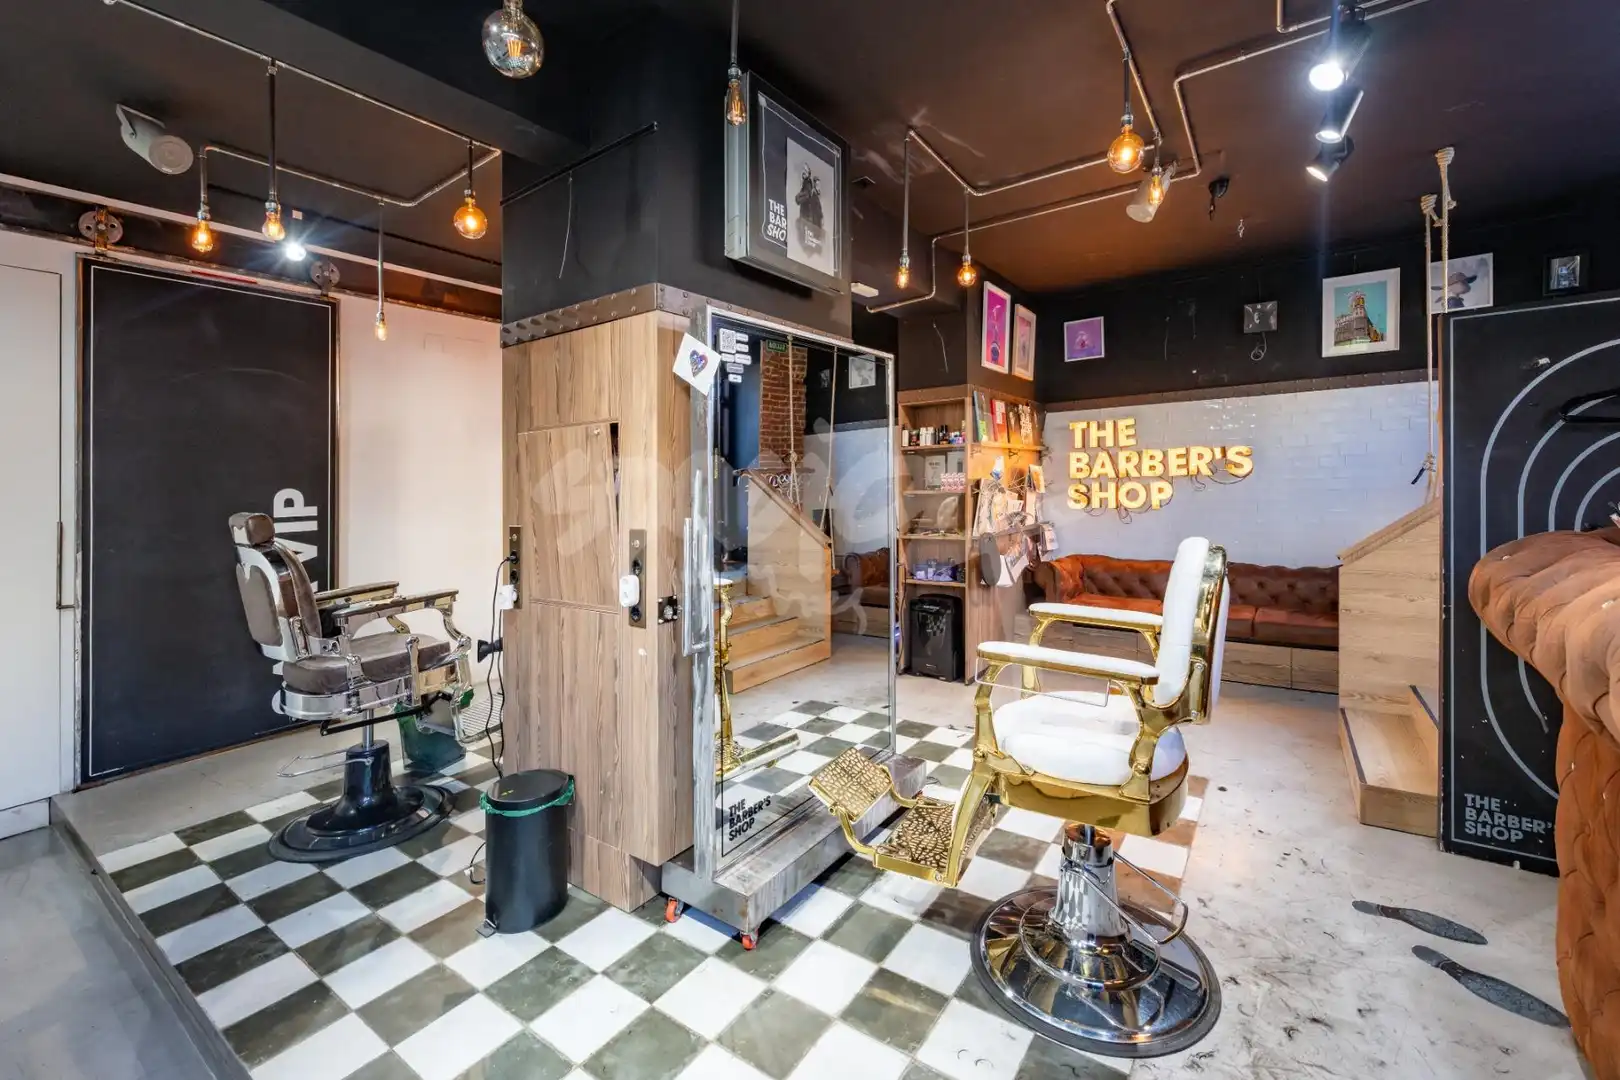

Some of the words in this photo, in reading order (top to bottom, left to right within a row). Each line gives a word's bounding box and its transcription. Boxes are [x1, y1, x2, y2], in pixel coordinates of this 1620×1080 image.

[768, 199, 785, 216] THE
[1069, 418, 1137, 449] THE
[1069, 446, 1253, 479] BARBER'S
[1067, 481, 1174, 510] SHOP
[729, 798, 746, 817] THE
[729, 796, 771, 829] BARBER'S
[1464, 793, 1501, 811] THE
[729, 817, 755, 841] SHOP
[1464, 821, 1524, 843] SHOP
